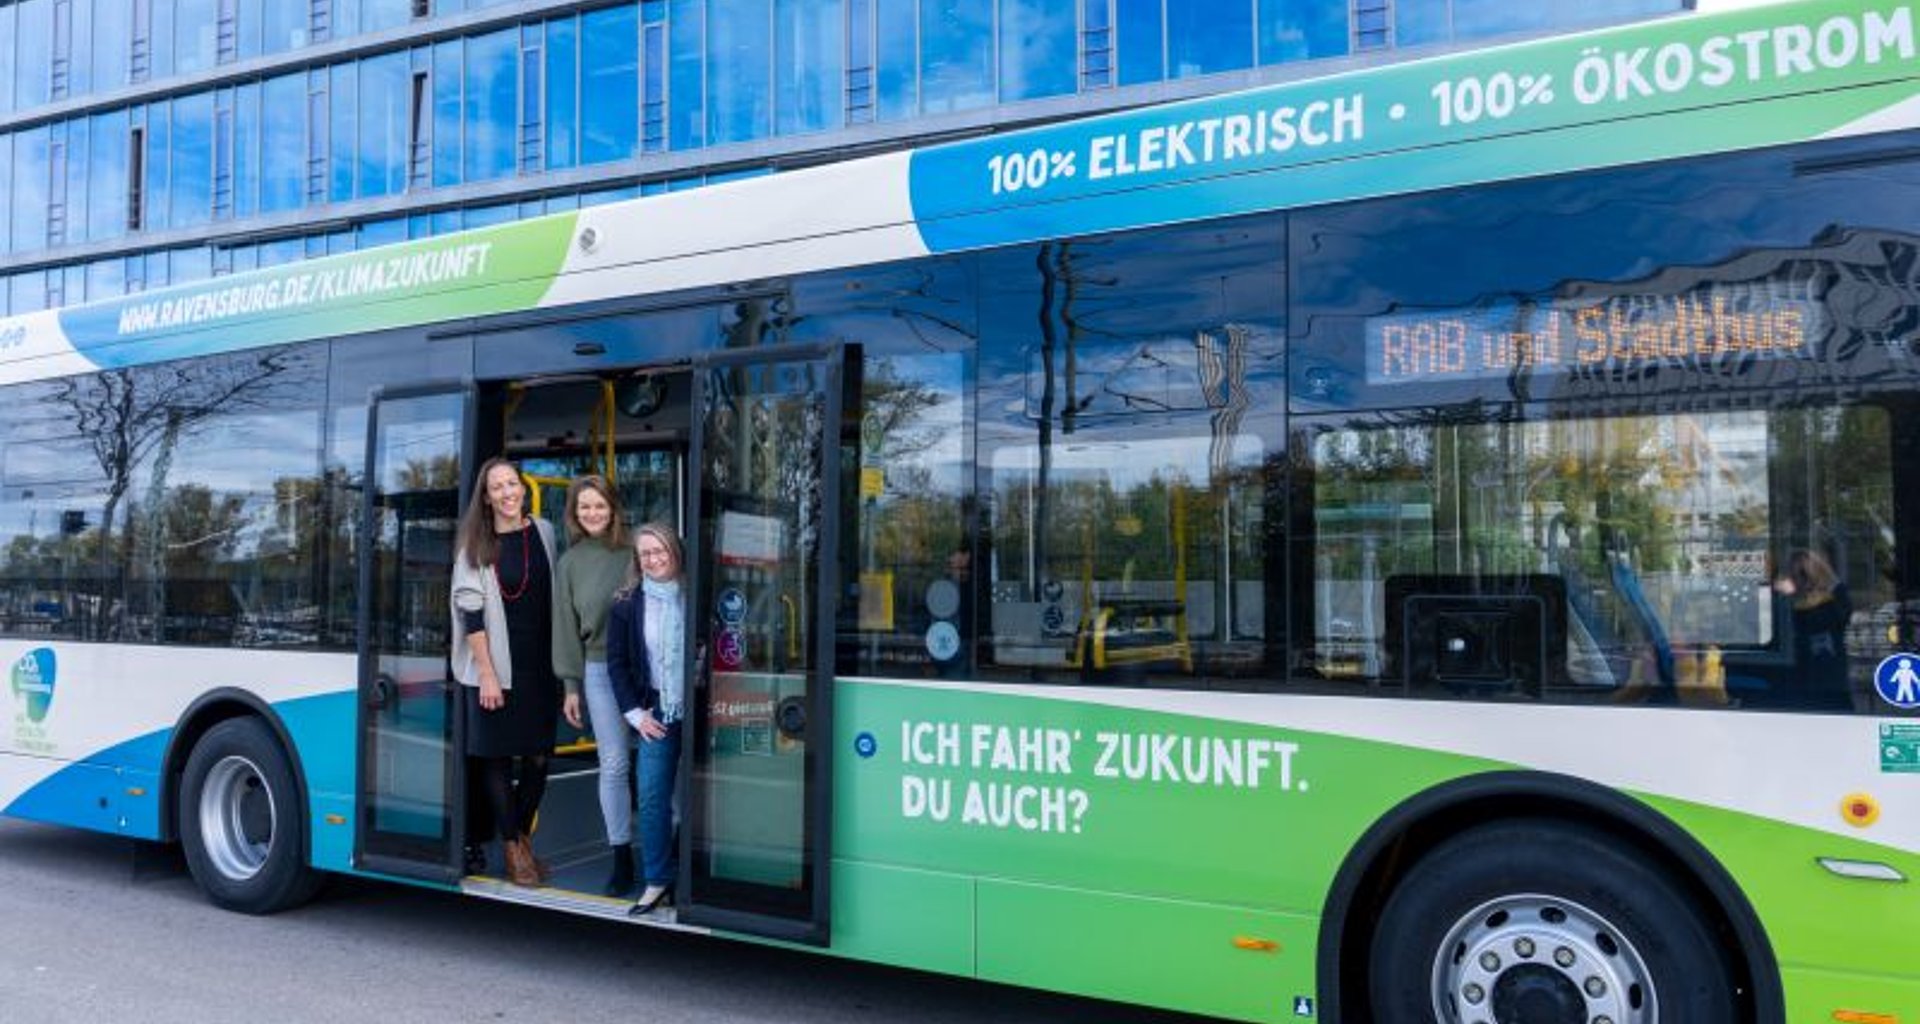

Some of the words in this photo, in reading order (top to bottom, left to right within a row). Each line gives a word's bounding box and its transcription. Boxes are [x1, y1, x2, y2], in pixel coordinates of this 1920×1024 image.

[988, 149, 1077, 195] 100%
[1088, 94, 1364, 180] ELEKTRISCH
[1431, 71, 1555, 126] 100%
[1572, 7, 1915, 105] ÖKOSTROM
[119, 243, 491, 333] WWW.RAVENSBURG.DE/KLIMAZUKUNFT
[1383, 320, 1466, 375] RAB
[1482, 309, 1560, 369] und
[1576, 297, 1802, 364] Stadtbus
[901, 721, 961, 766] ICH
[1093, 733, 1309, 793] ZUKUNFT.
[901, 775, 952, 821] DU
[961, 781, 1089, 834] AUCH?
